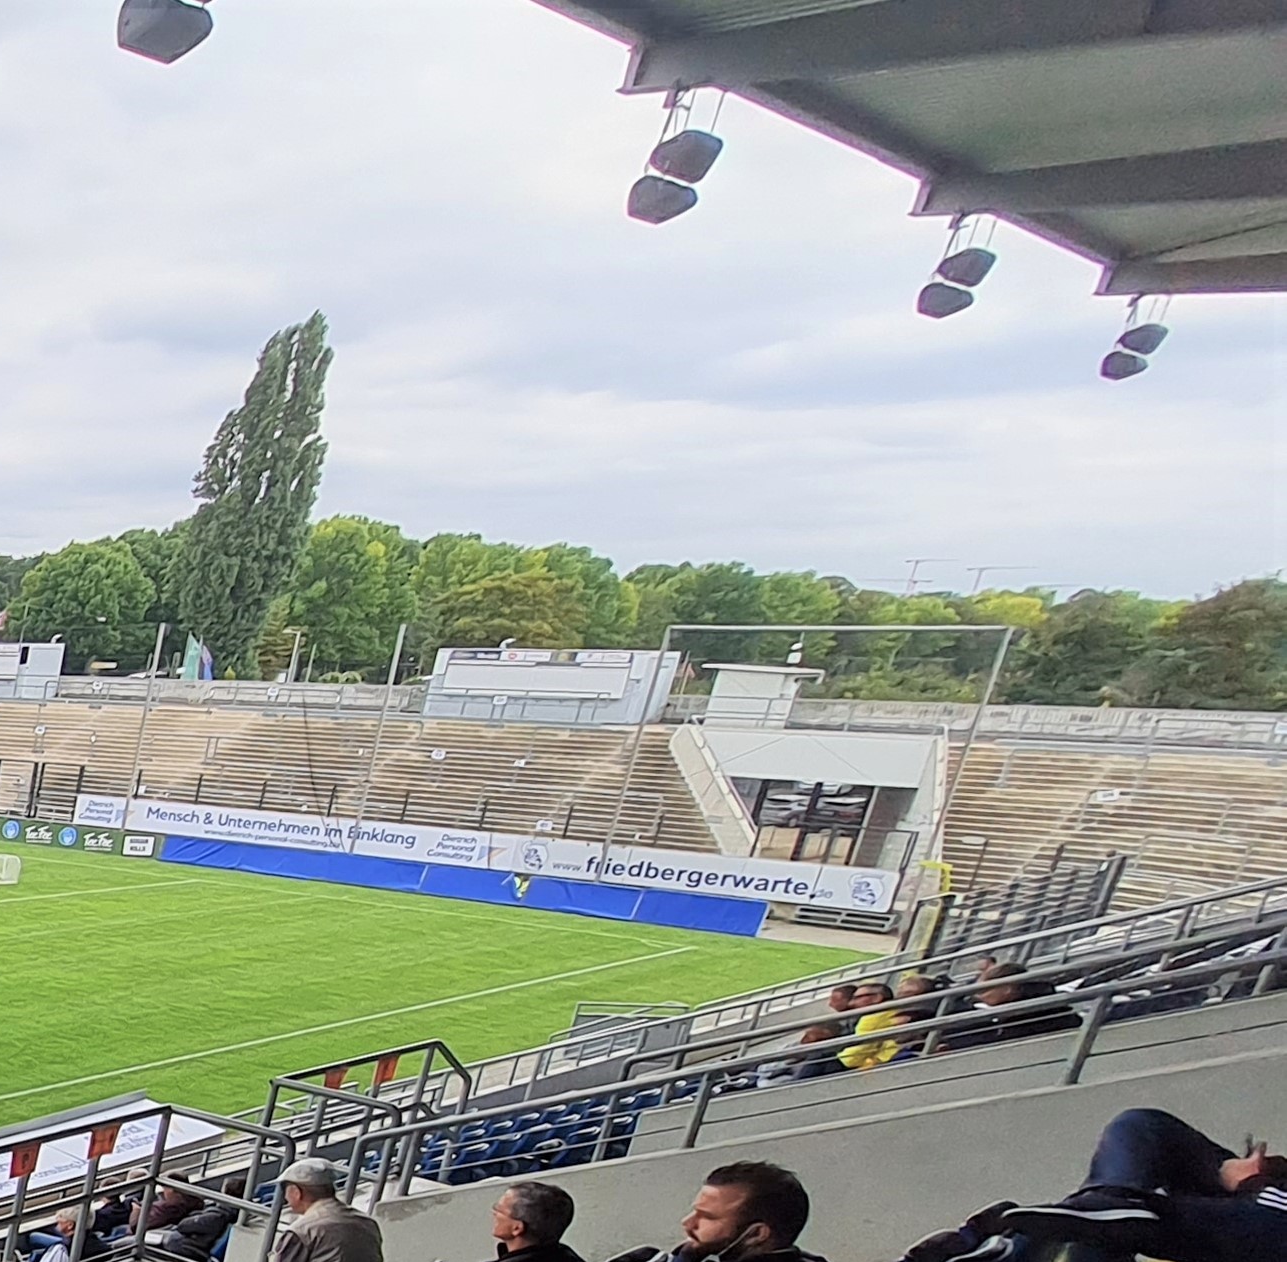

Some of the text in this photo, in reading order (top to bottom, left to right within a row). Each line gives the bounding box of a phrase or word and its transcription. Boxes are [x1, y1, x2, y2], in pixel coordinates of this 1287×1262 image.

[146, 807, 417, 848] Mensch & Unternehmen im Einklang
